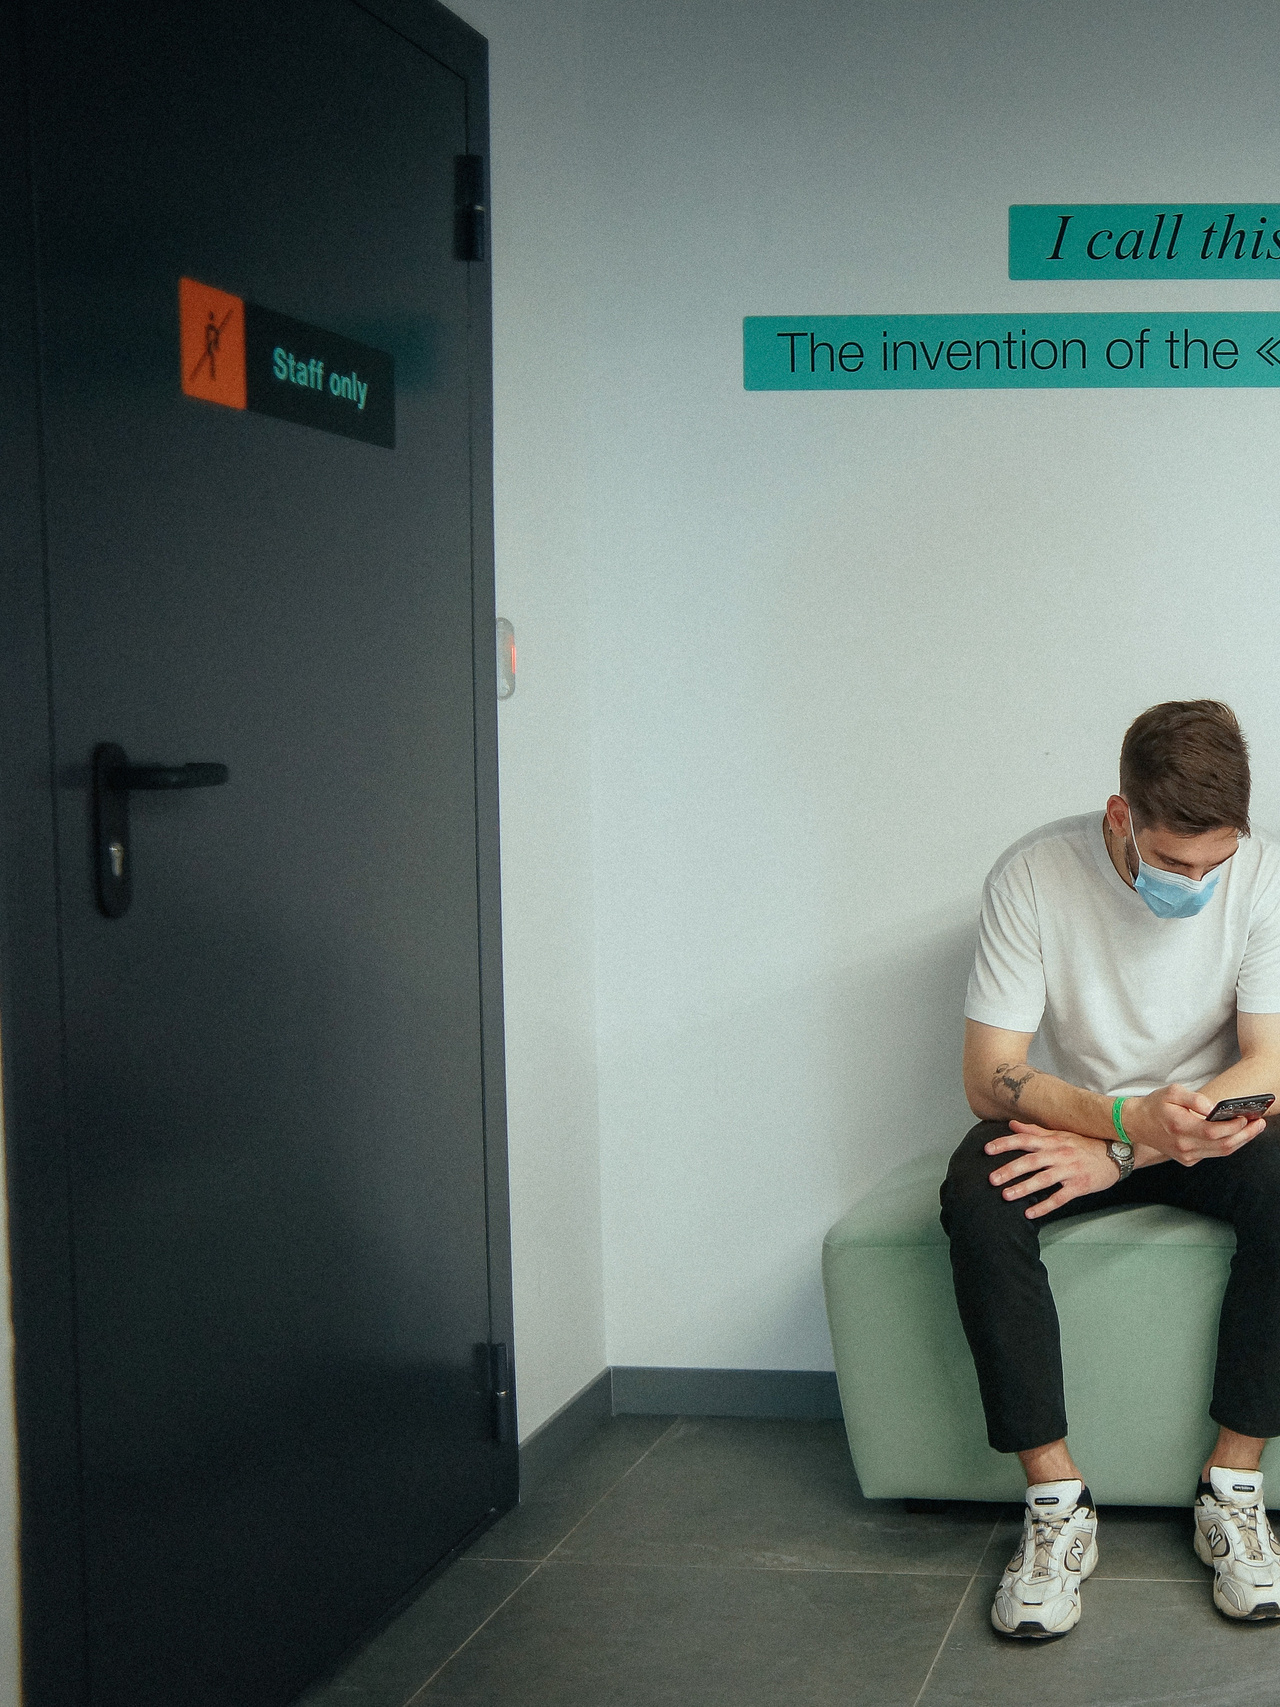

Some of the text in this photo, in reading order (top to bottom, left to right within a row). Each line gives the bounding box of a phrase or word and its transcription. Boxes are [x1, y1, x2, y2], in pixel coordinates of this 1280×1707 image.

[1046, 215, 1073, 260] I
[1086, 213, 1183, 260] call
[776, 332, 864, 373] The
[882, 328, 1087, 372] invention
[1105, 328, 1151, 370] of
[1164, 328, 1239, 370] the
[273, 347, 368, 409] Staff only
